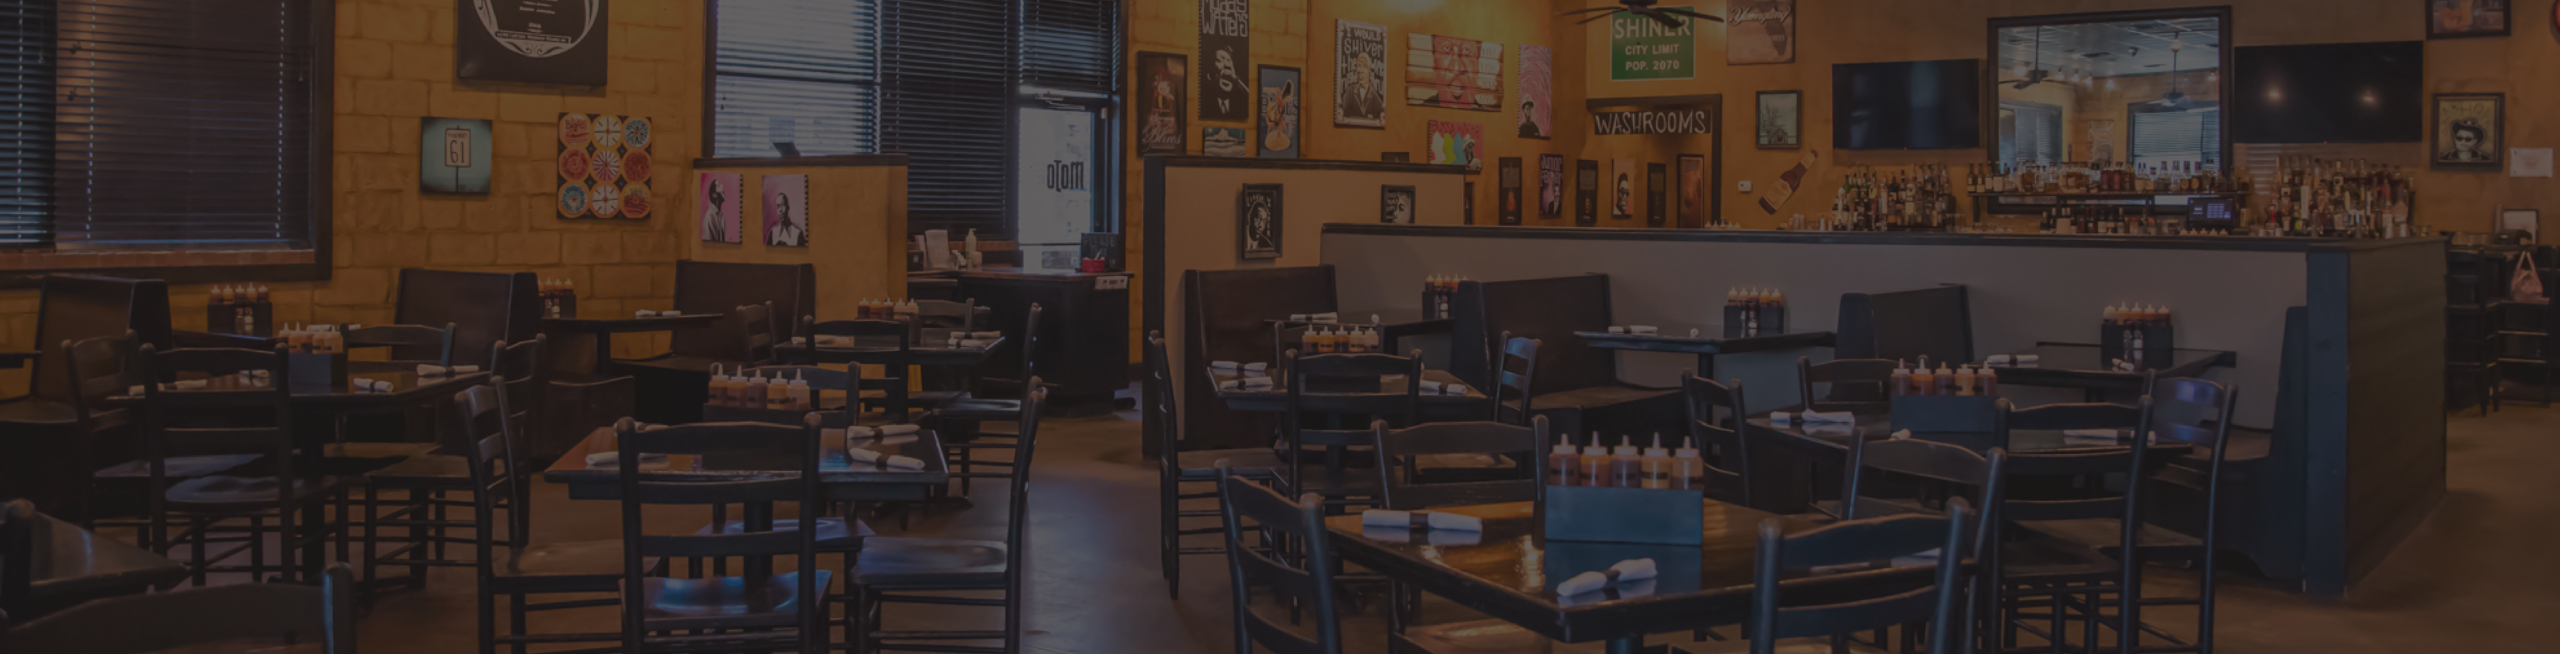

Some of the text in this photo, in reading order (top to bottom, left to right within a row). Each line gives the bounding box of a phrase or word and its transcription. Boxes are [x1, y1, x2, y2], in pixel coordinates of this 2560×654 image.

[1625, 43, 1680, 55] CITY LIMIT
[1625, 60, 1680, 71] POP. 2070
[1594, 110, 1706, 134] WASHROOMS
[450, 139, 464, 164] 61
